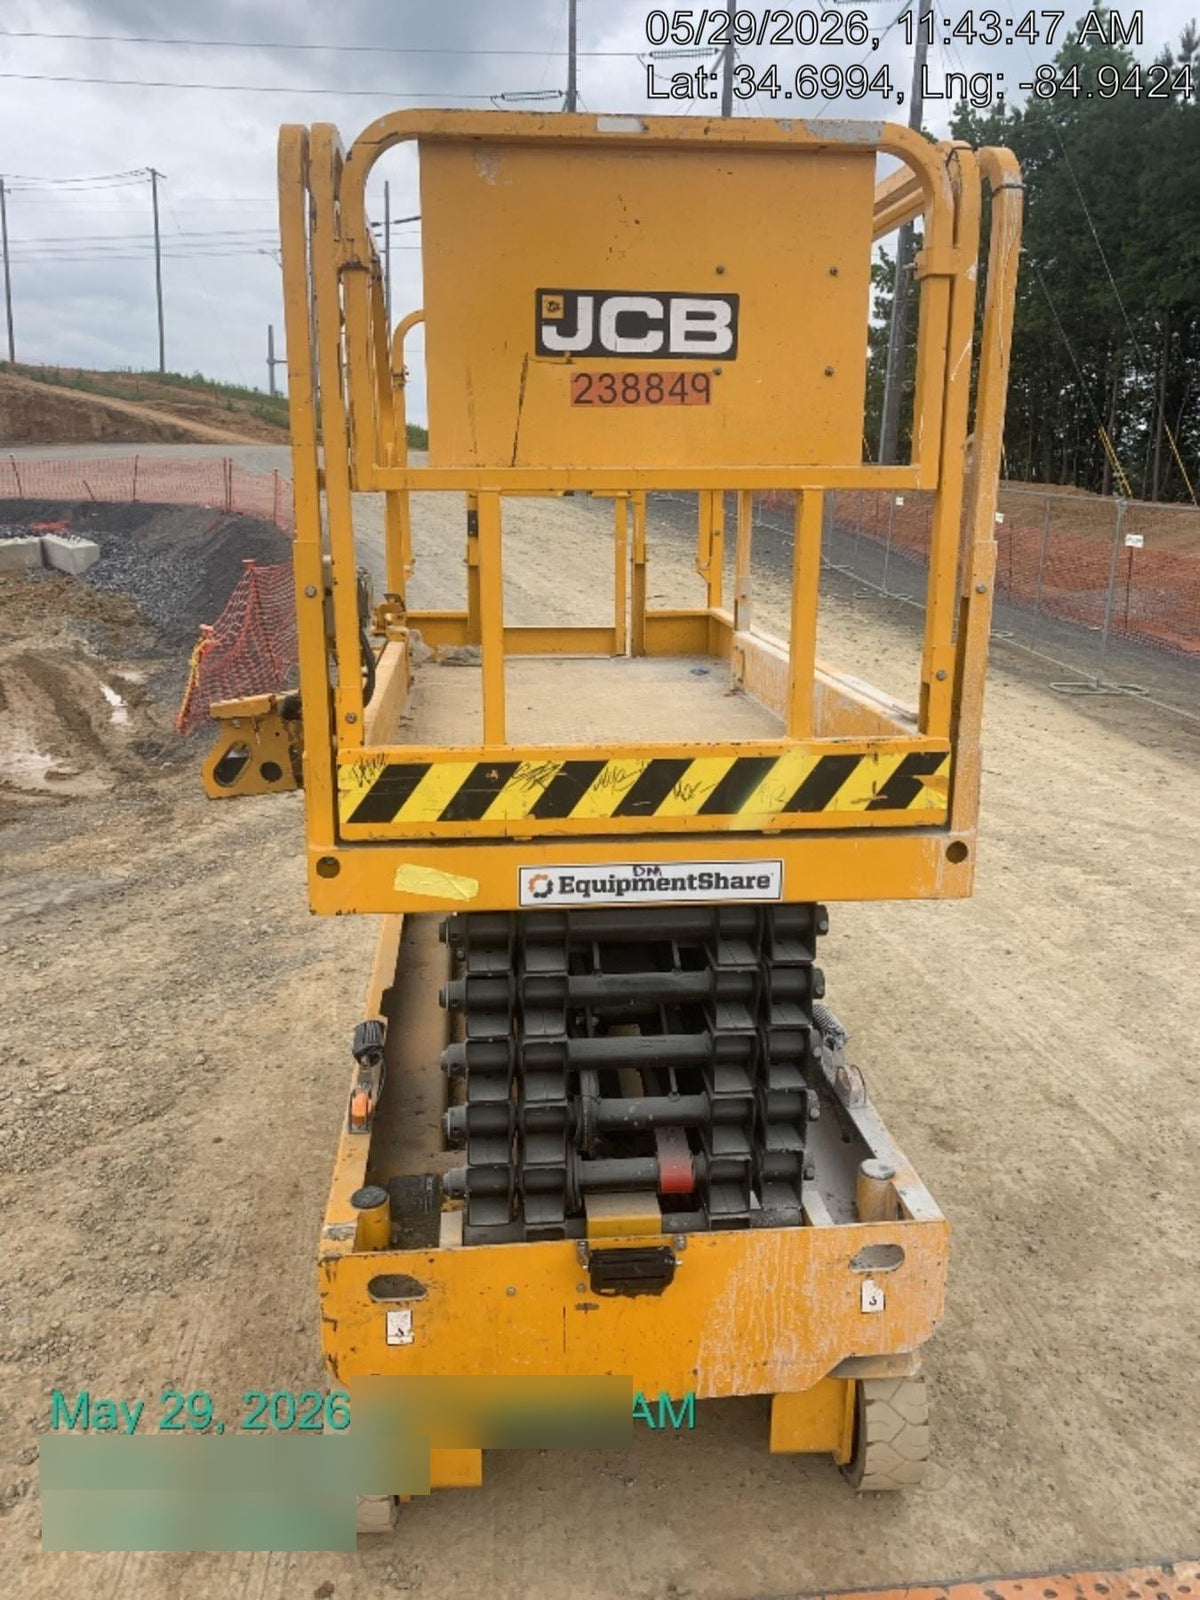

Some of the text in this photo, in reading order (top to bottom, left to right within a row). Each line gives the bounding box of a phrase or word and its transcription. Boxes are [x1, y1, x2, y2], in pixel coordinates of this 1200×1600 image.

[541, 296, 733, 354] JCB
[573, 372, 710, 404] 238849
[558, 872, 770, 898] EquipmentShare
